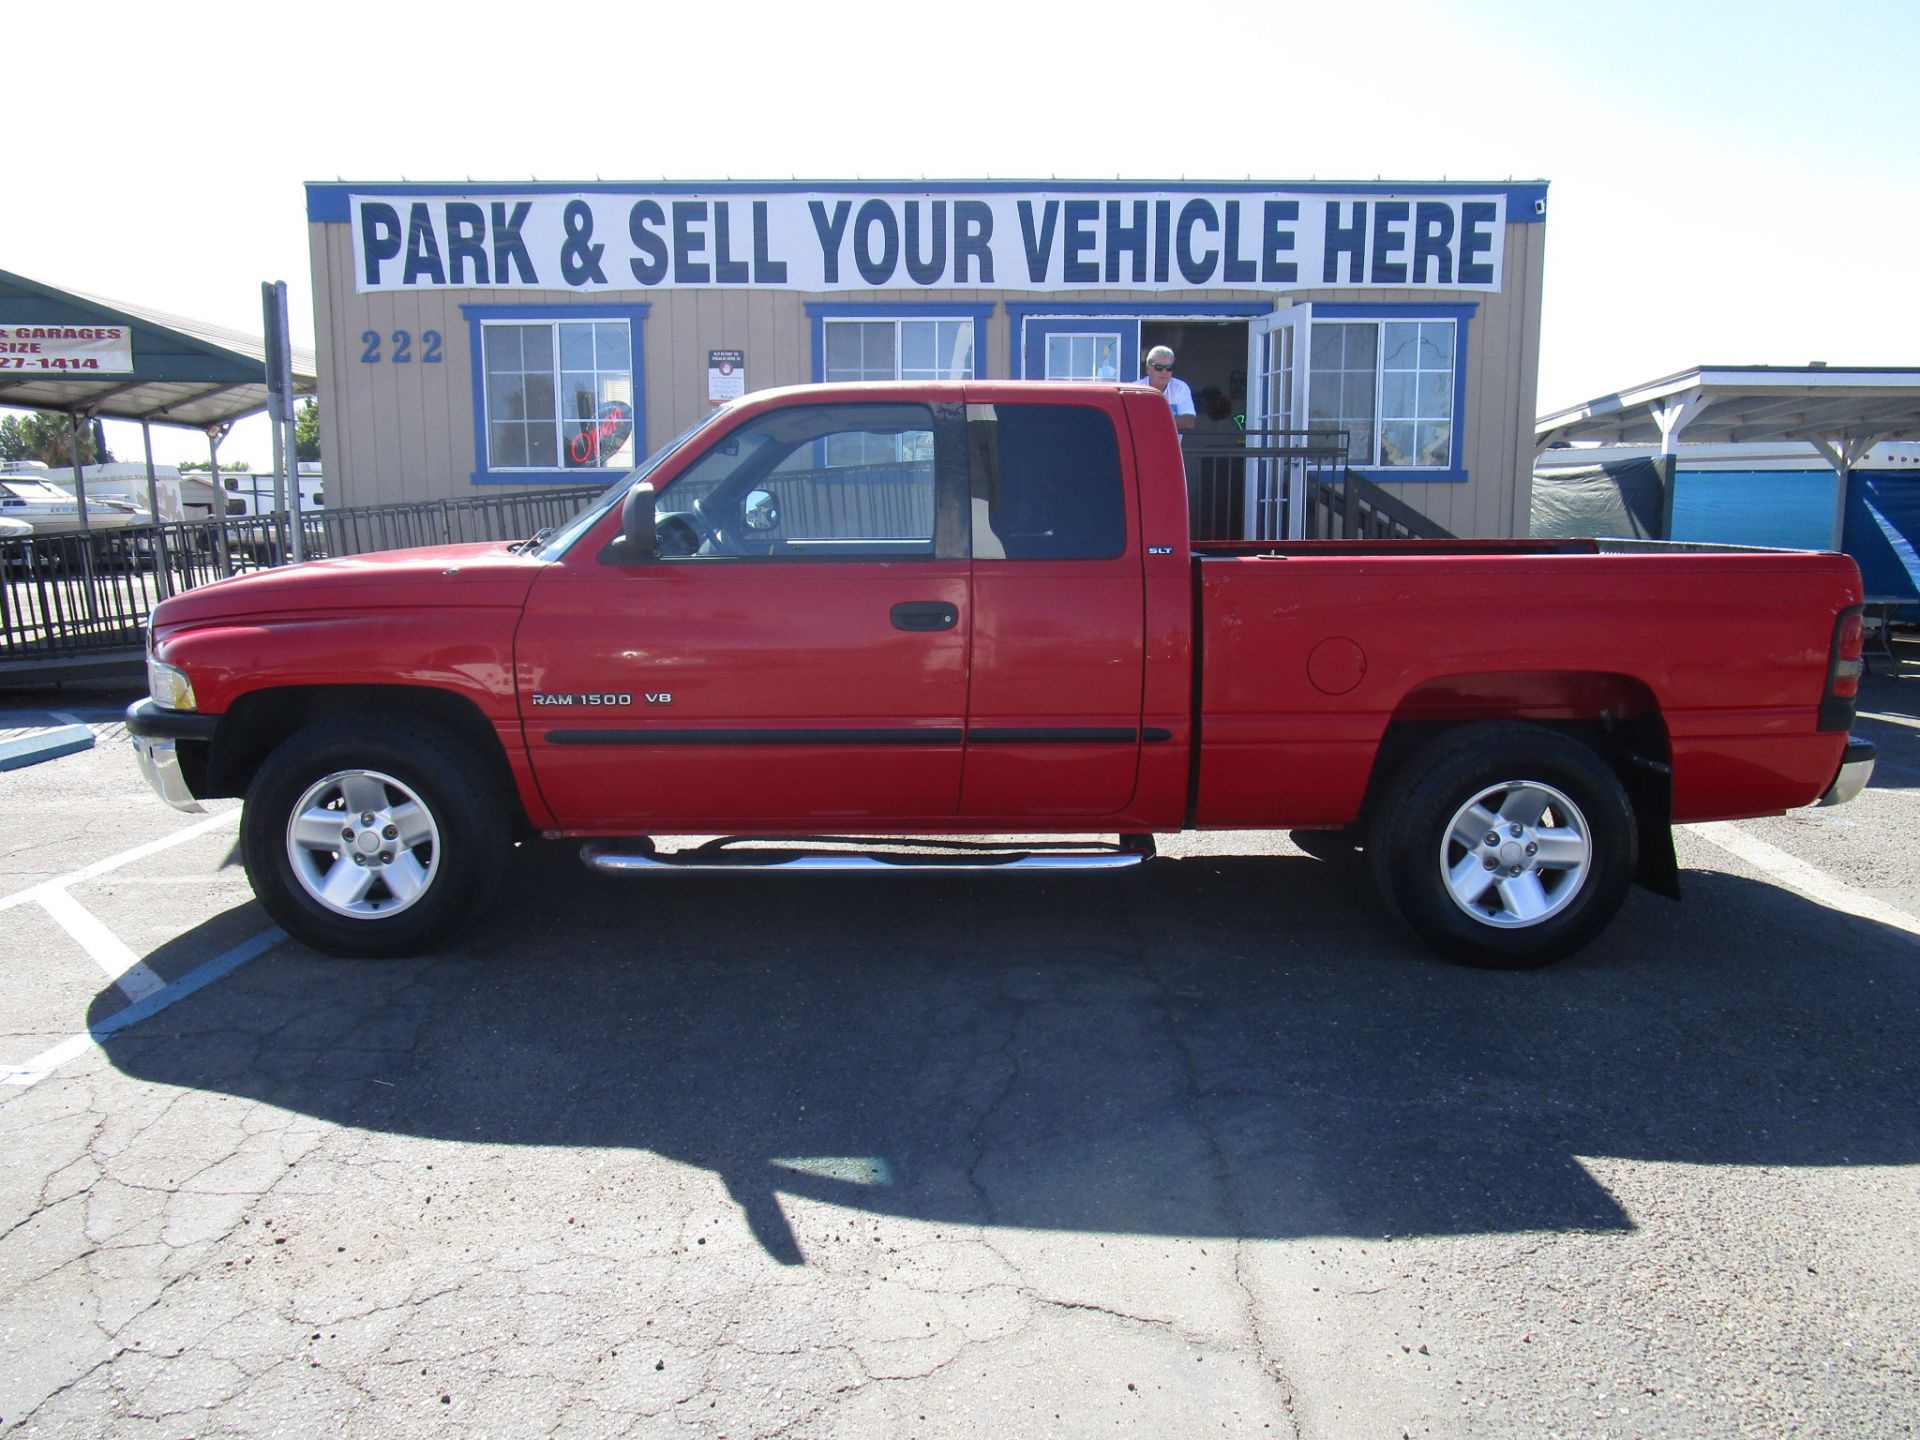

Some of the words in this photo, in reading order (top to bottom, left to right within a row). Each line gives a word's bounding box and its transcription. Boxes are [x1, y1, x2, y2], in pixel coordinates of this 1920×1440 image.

[360, 201, 539, 285] PARK
[560, 199, 608, 286] &
[628, 199, 788, 286] SELL
[807, 198, 995, 286] YOUR
[1016, 198, 1300, 285] VEHICLE
[1322, 200, 1498, 284] HERE
[16, 328, 121, 339] GARAGES
[0, 343, 41, 353] SIZE
[361, 330, 442, 363] 222
[532, 694, 573, 705] RAM
[581, 694, 631, 705] 1500
[645, 693, 672, 702] V8
